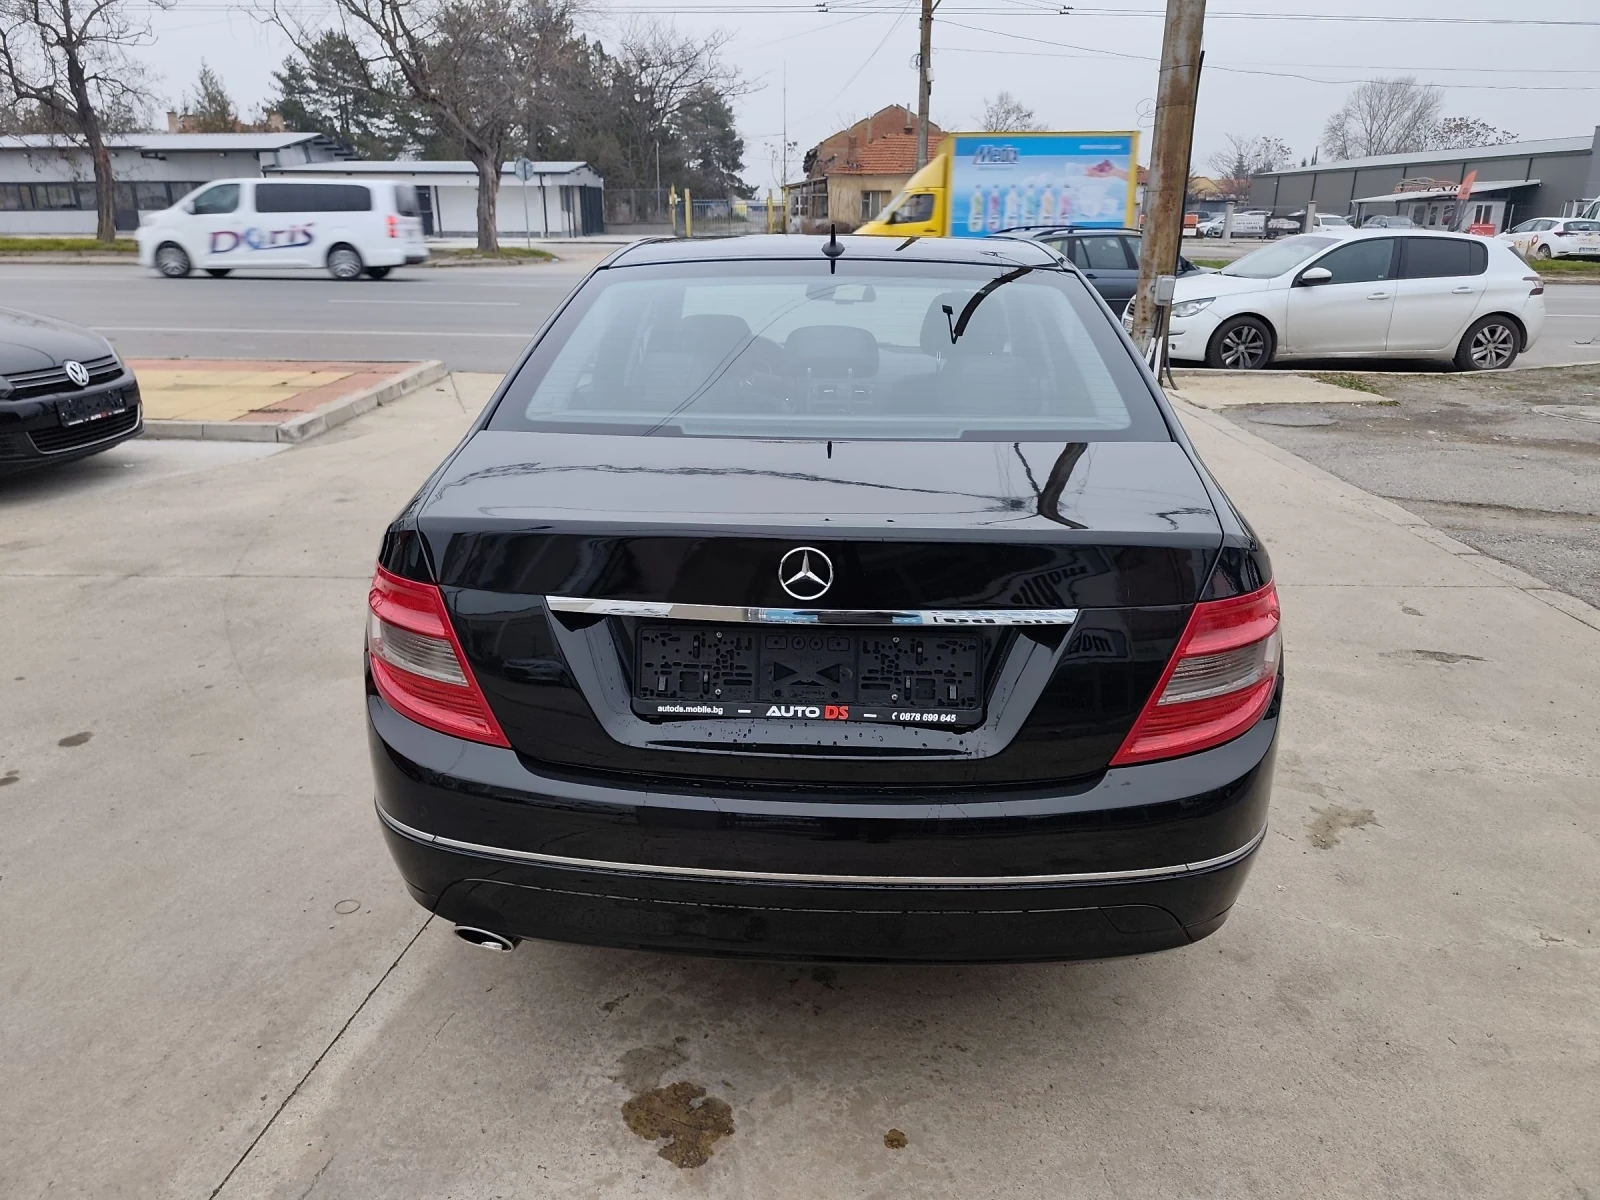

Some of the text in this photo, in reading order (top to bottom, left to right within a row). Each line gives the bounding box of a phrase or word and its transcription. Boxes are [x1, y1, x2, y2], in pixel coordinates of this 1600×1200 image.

[657, 705, 957, 722] autods.mobile.bg AUTO DS 0878 699 645
